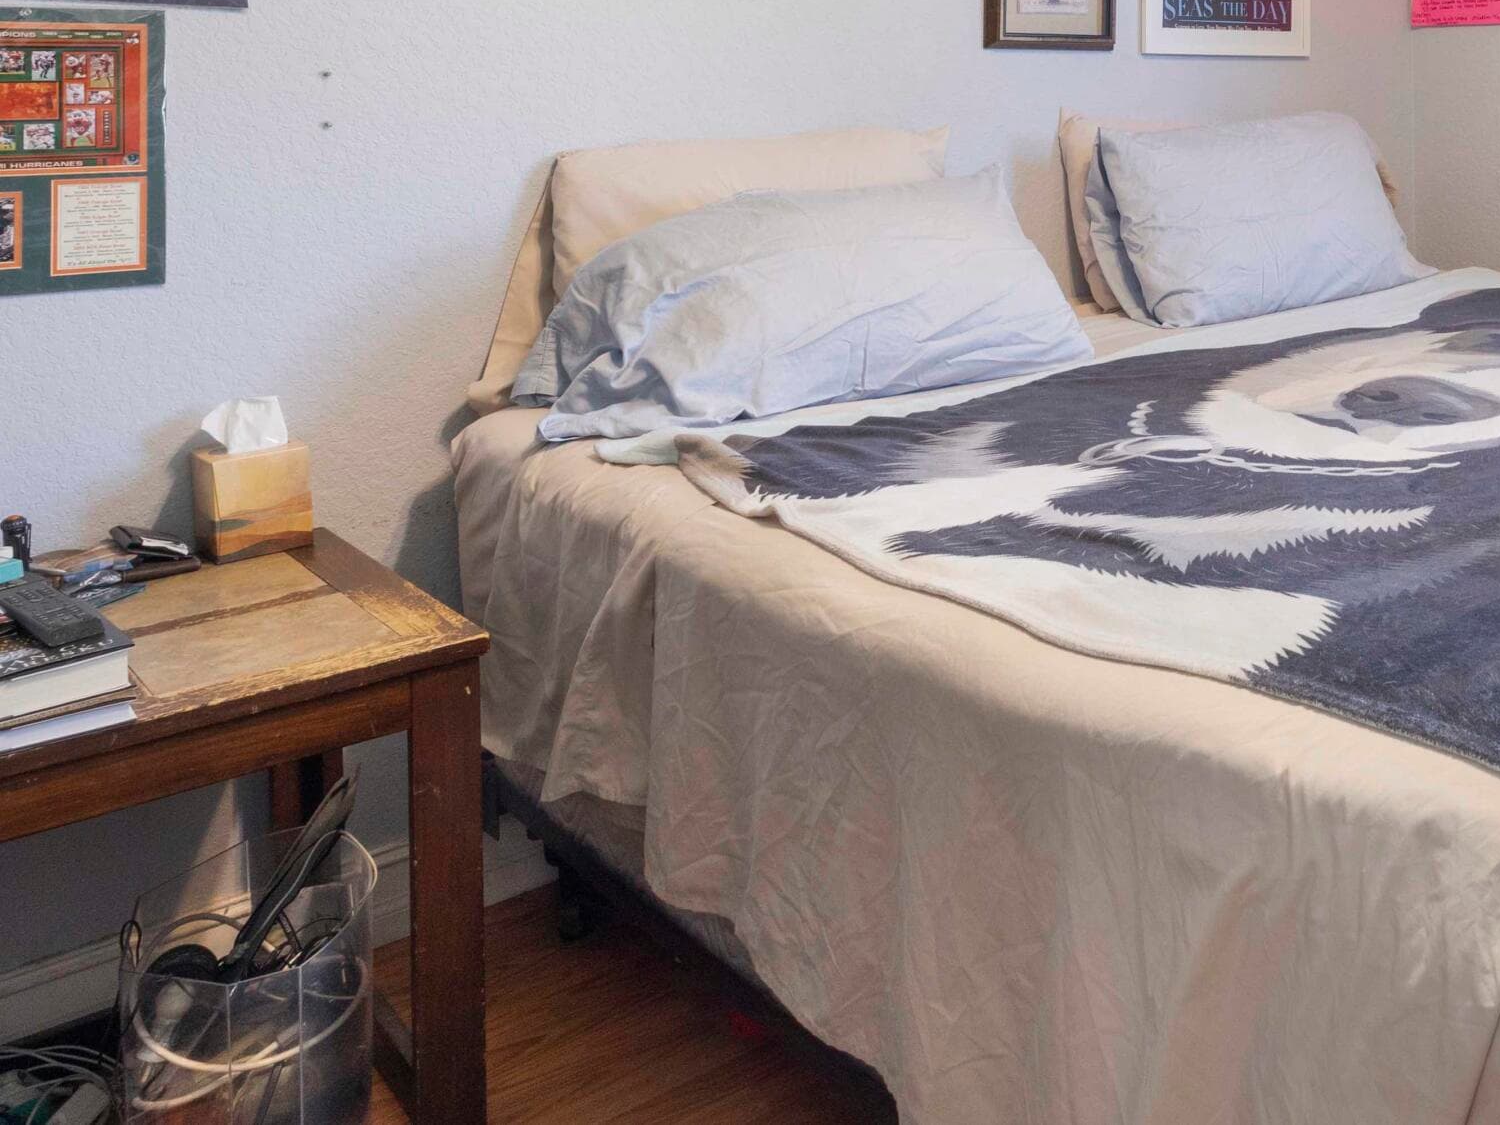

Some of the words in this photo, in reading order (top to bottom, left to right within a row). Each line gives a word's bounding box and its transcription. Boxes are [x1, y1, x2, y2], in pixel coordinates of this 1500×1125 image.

[1221, 1, 1249, 17] THE
[1252, 0, 1290, 25] DAY
[9, 160, 84, 170] HURRICANES
